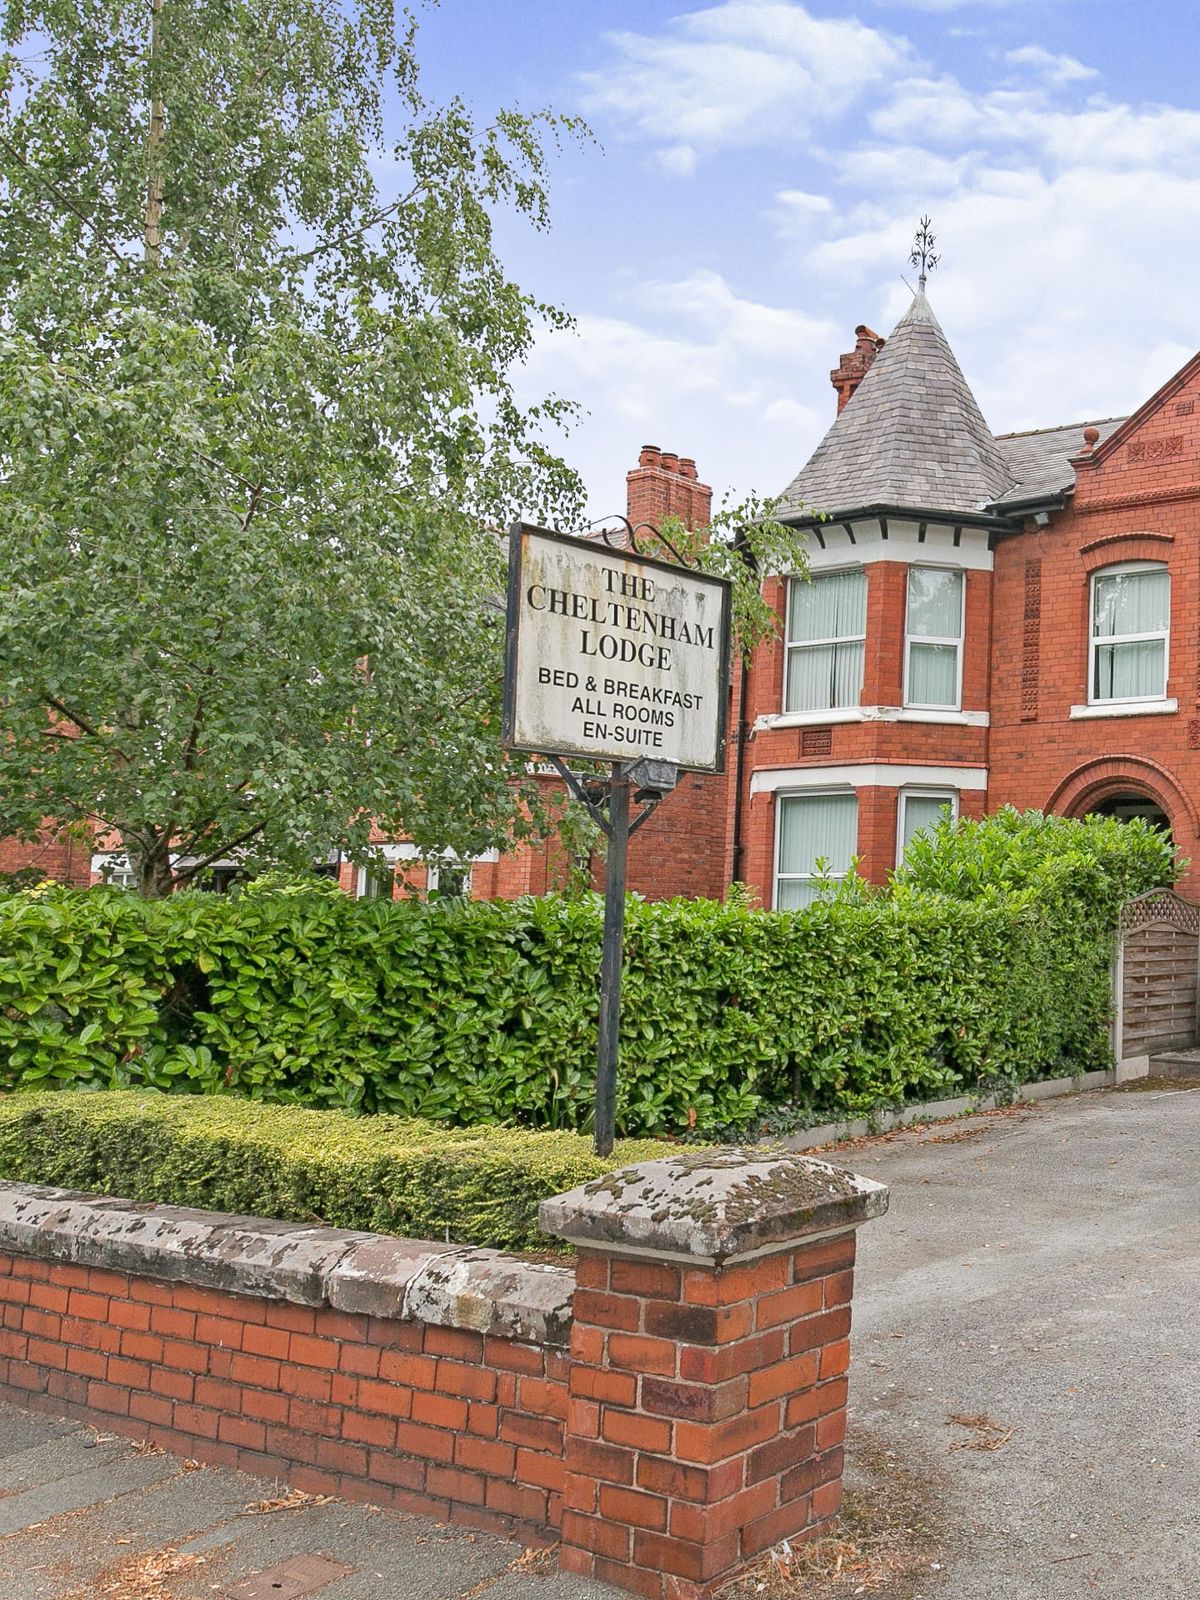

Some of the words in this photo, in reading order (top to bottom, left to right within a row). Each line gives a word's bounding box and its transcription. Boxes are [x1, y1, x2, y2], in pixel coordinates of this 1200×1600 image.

[601, 567, 655, 603] THE
[527, 584, 714, 649] CHELTENHAM
[579, 629, 672, 671] LODGE
[538, 667, 579, 689] BED
[585, 676, 597, 692] &
[603, 679, 703, 711] BREAKFAST
[571, 697, 607, 717] ALL
[613, 703, 675, 727] ROOMS
[583, 721, 663, 747] EN-SUITE
